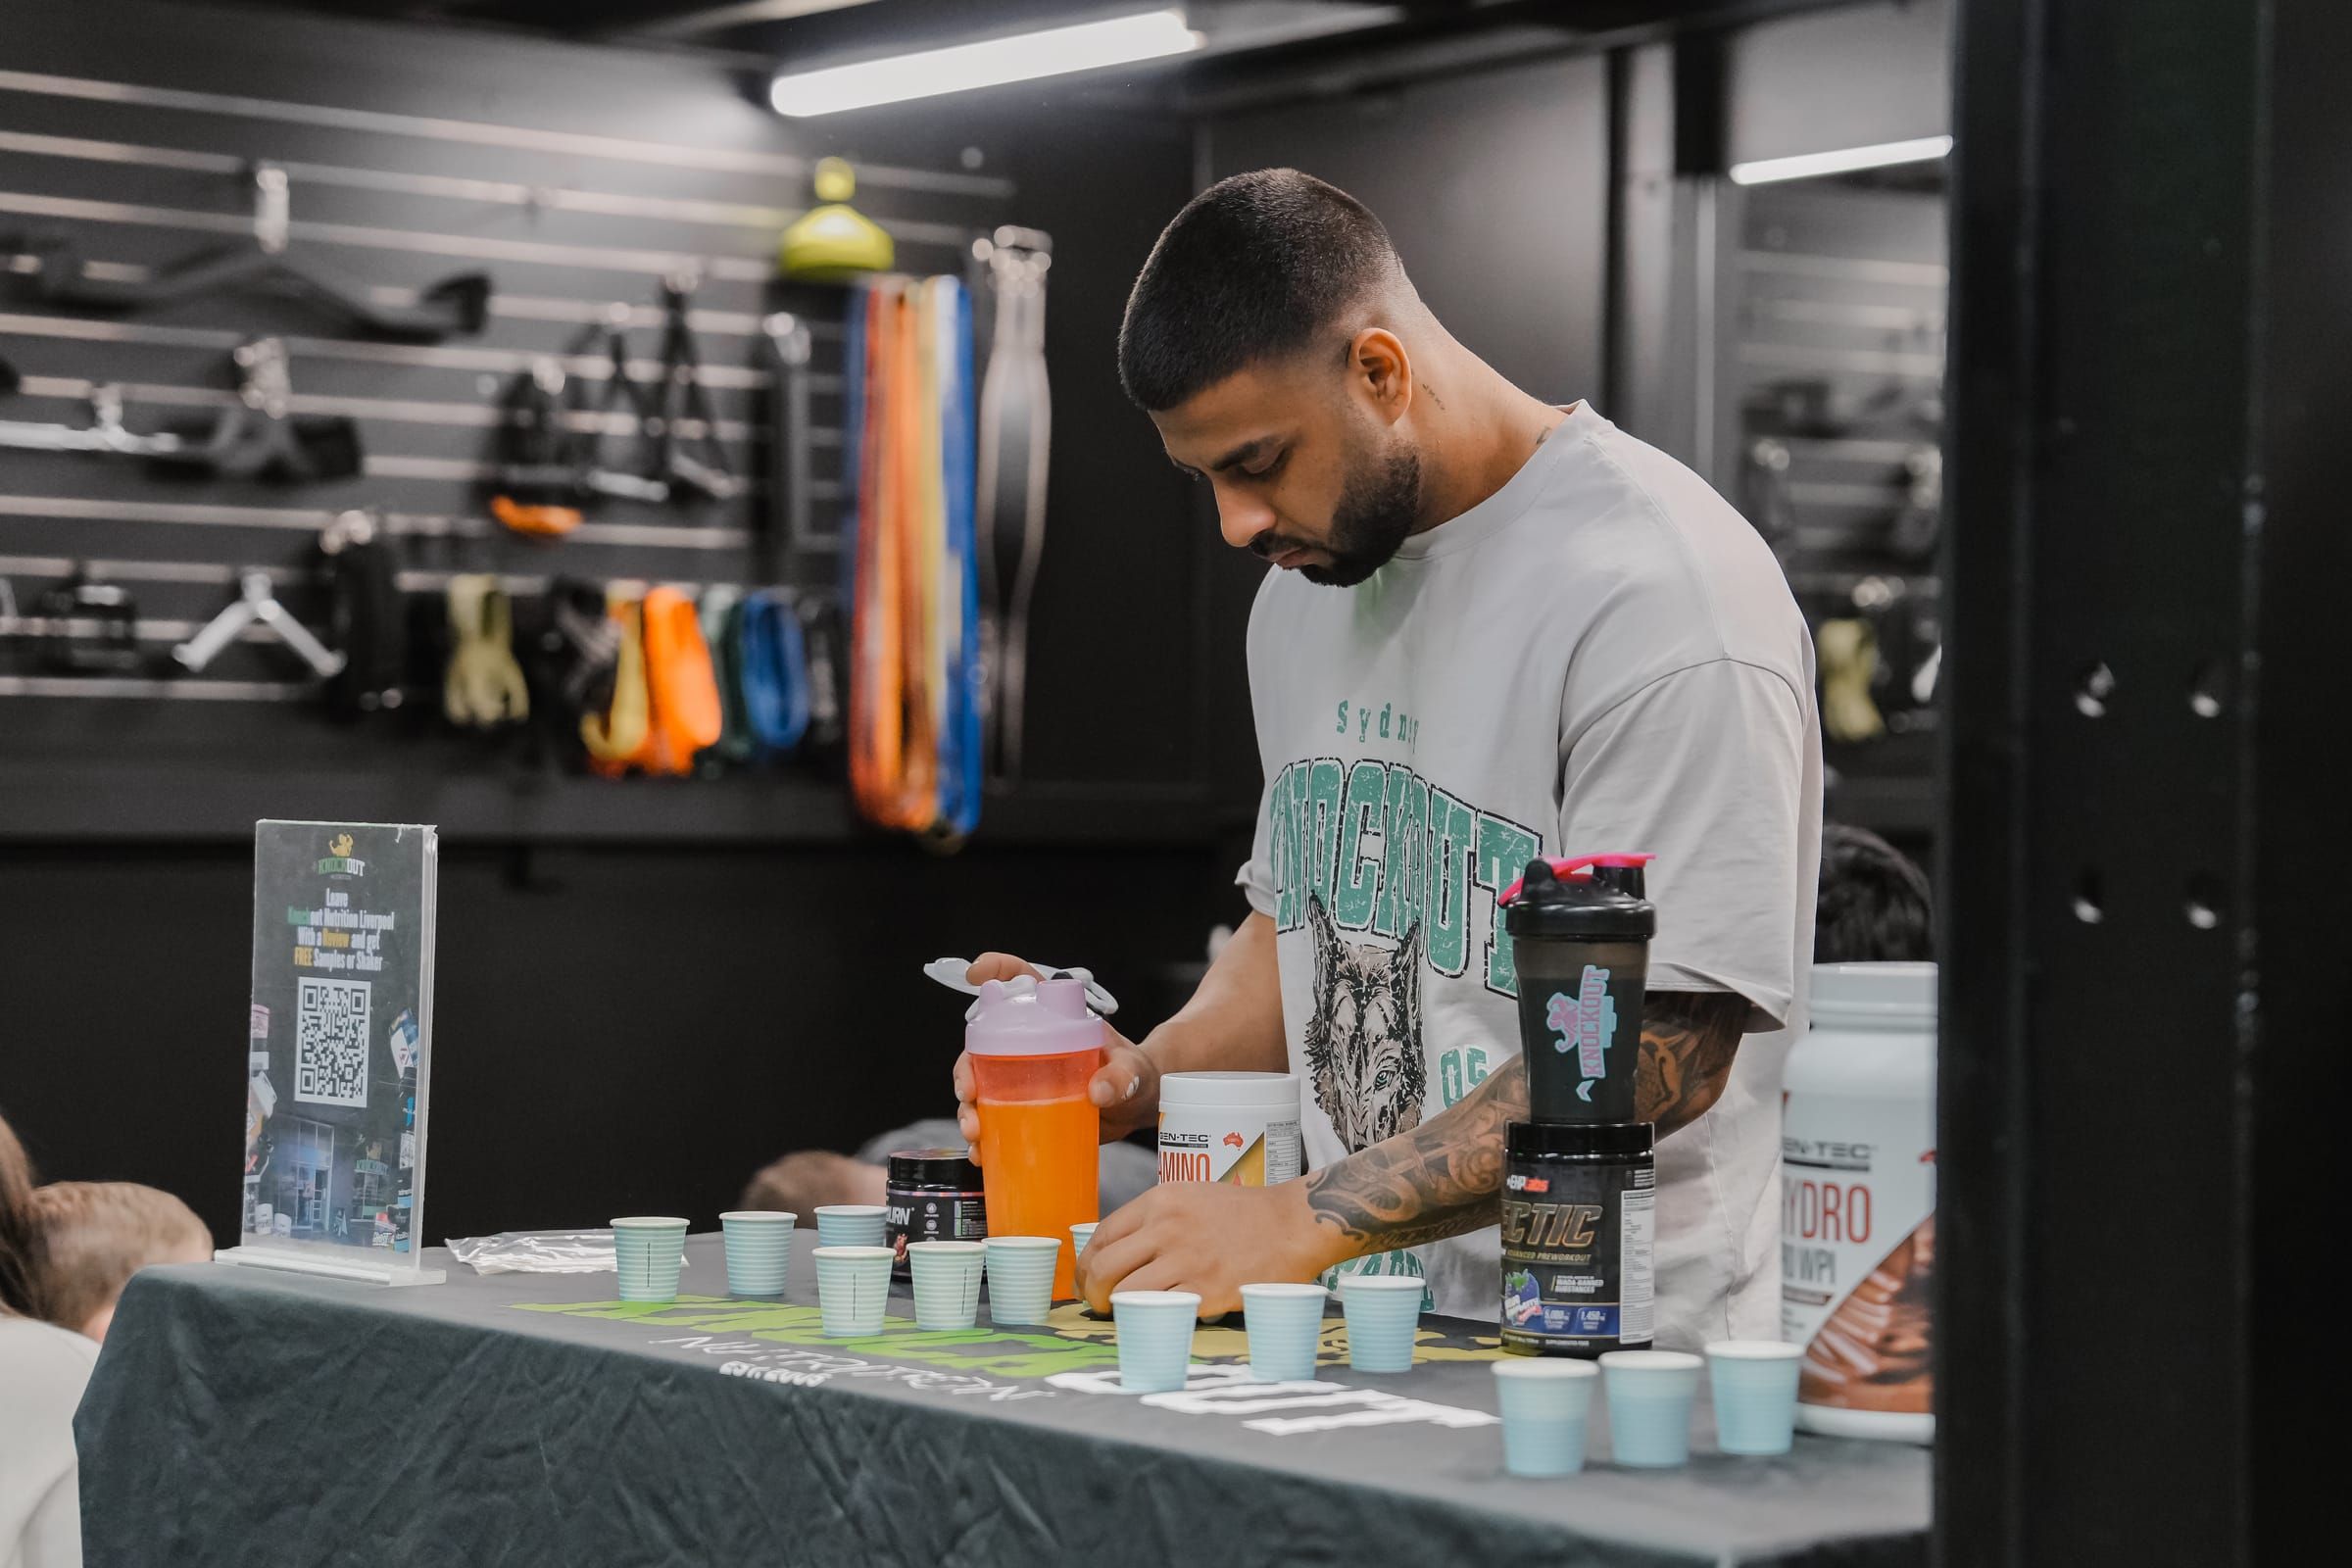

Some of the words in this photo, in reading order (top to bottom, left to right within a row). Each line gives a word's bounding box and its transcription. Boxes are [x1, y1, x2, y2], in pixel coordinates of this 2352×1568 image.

[318, 857, 366, 877] KNOCKOUT
[325, 888, 348, 907] Leave
[323, 907, 359, 929] Nutrition
[359, 909, 395, 933] Liverpool
[294, 947, 314, 966] FREE
[314, 948, 346, 972] Samples
[356, 951, 383, 971] Shaker
[1581, 967, 1607, 1077] KNOCKOUT
